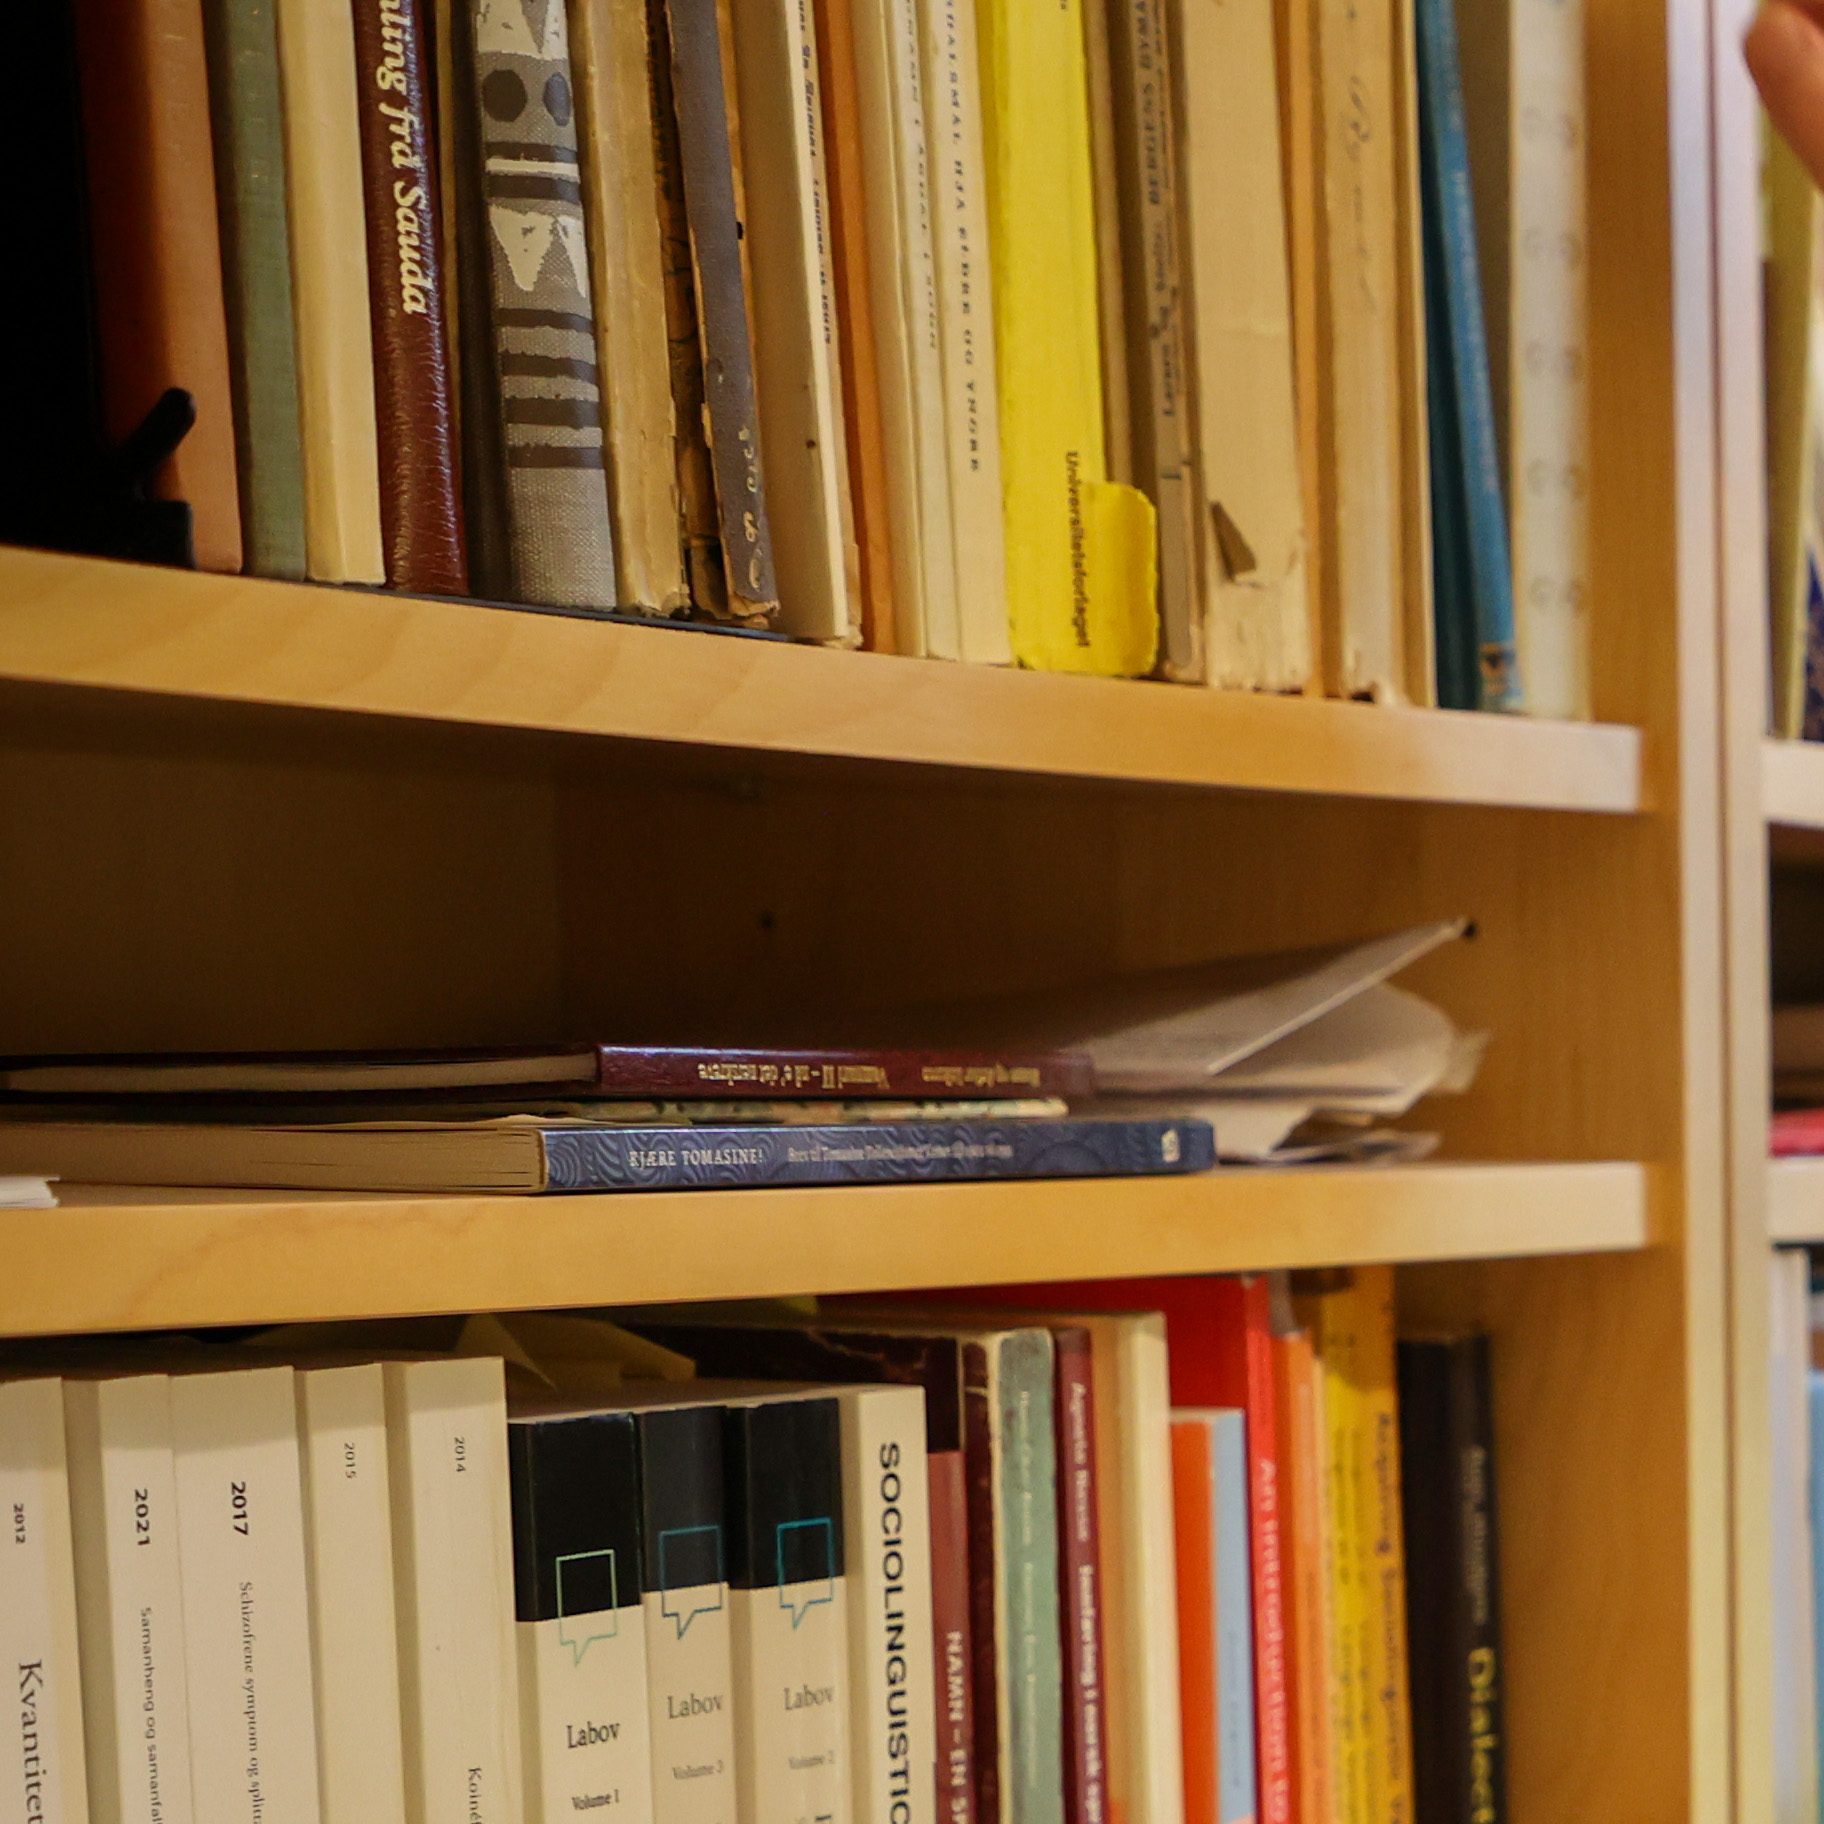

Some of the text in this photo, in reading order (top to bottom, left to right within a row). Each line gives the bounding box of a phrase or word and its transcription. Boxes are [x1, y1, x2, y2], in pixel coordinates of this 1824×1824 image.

[393, 181, 434, 315] Sauda
[1065, 451, 1092, 649] Universitetsforlaget
[680, 1147, 764, 1166] TOMASINE!
[343, 1441, 357, 1480] 2015
[453, 1435, 467, 1474] 2014
[12, 1502, 27, 1546] 2012
[134, 1487, 152, 1548] 2021
[230, 1480, 250, 1537] 2017
[237, 1580, 257, 1674] Schizofrene
[139, 1606, 158, 1712] Samanheng
[947, 1630, 966, 1722] NAMN
[241, 1677, 259, 1752] symptom
[667, 1694, 724, 1720] Labov
[784, 1682, 836, 1712] Labov
[145, 1715, 158, 1741] og
[566, 1720, 621, 1749] Labov
[247, 1757, 260, 1777] og
[951, 1749, 969, 1787] EN
